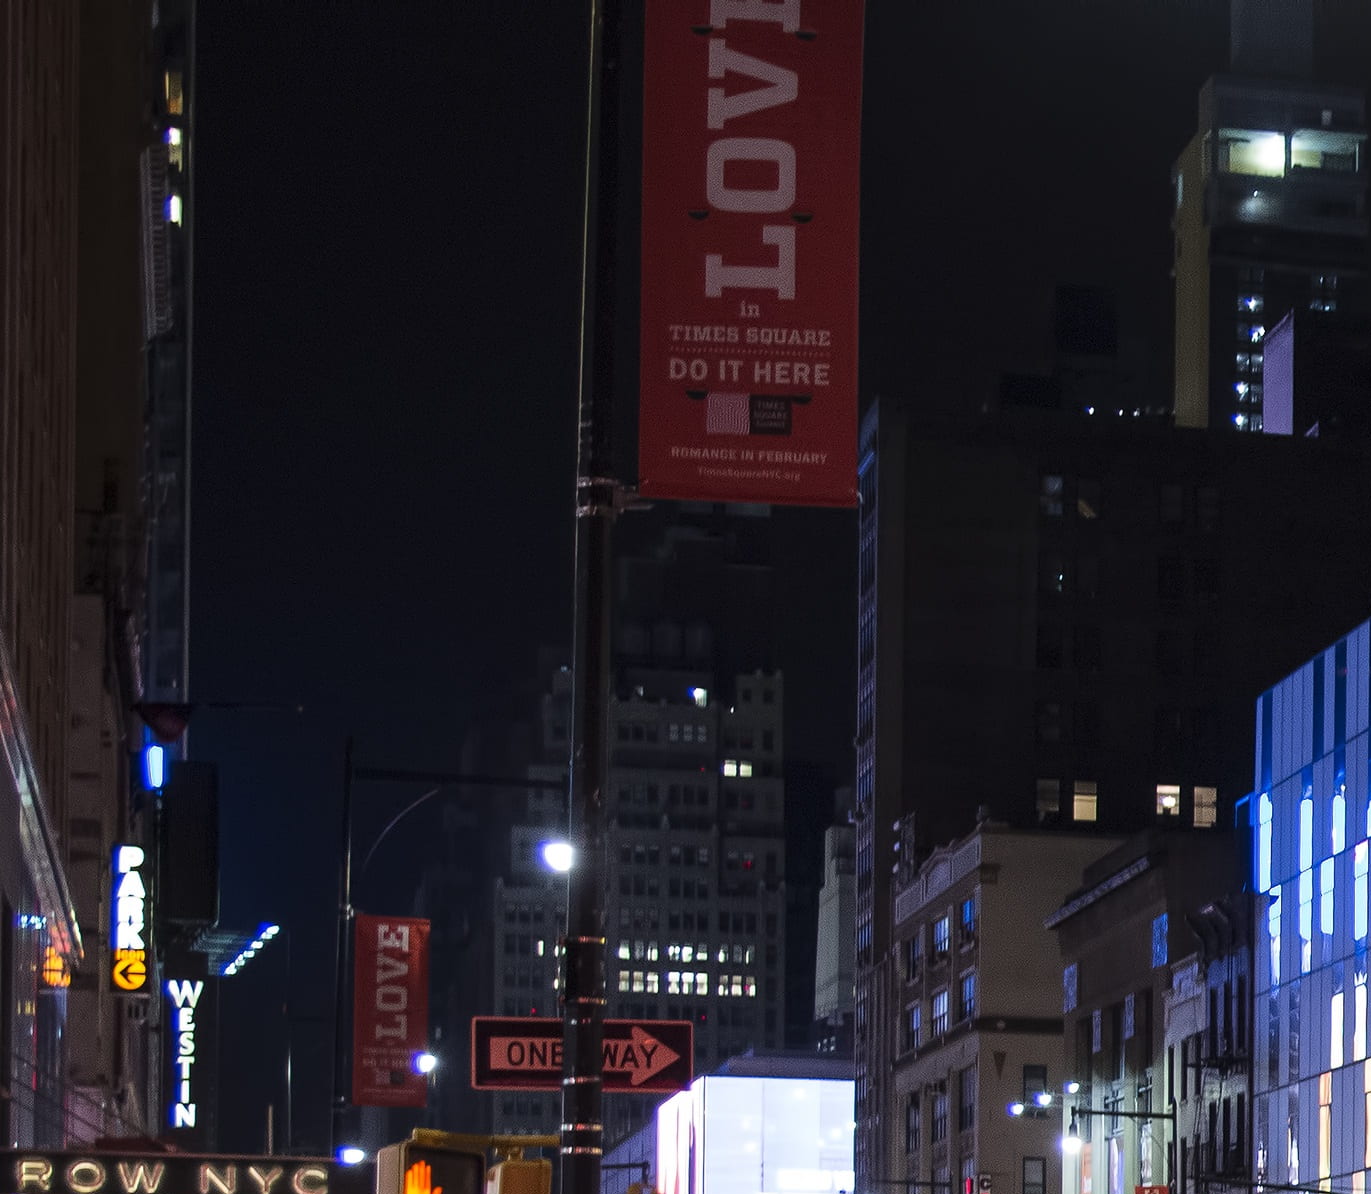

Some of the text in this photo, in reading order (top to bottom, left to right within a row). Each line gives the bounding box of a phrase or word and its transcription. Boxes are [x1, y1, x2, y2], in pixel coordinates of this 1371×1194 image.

[739, 300, 760, 319] in
[669, 324, 831, 348] TIMES SQUARE
[669, 358, 831, 387] DO IT HERE
[671, 446, 828, 466] ROMANCE IN FEBRUARY
[117, 845, 146, 950] PARK
[374, 923, 410, 1042] LOVE
[167, 979, 204, 1128] WESTIN
[506, 1040, 660, 1069] ONE WAY
[16, 1158, 166, 1194] ROW
